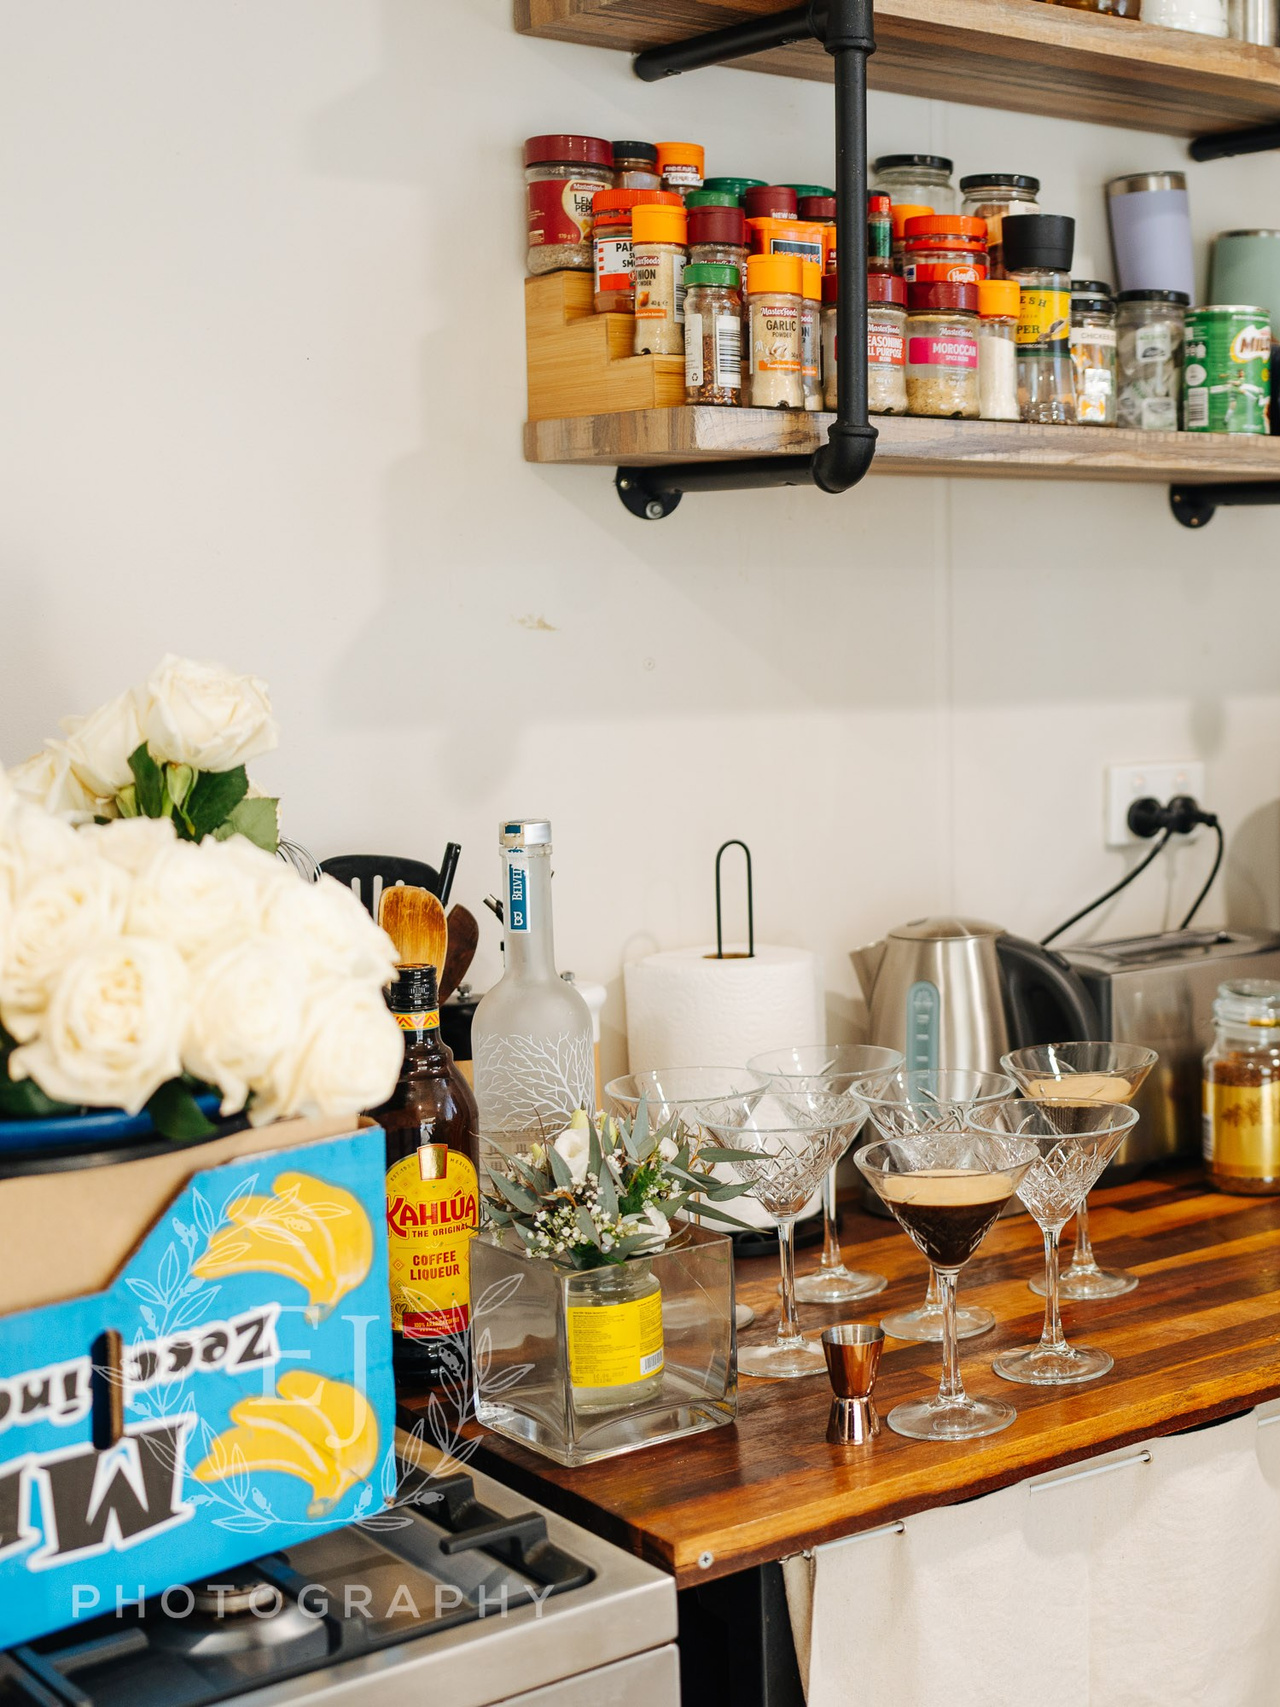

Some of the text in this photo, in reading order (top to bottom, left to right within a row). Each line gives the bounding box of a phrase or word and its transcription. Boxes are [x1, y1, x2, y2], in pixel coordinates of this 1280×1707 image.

[1020, 296, 1047, 308] ESH
[765, 319, 797, 332] GARLIC
[1016, 325, 1041, 335] PER
[867, 335, 903, 350] EASONING
[932, 342, 977, 357] MOROCCAN
[876, 346, 903, 359] PURPOSE
[511, 868, 523, 902] BELVED
[386, 1189, 477, 1238] KAHLÚA
[411, 1230, 430, 1238] THE
[412, 1250, 457, 1267] COFFEE
[409, 1263, 461, 1281] LIQUEUR
